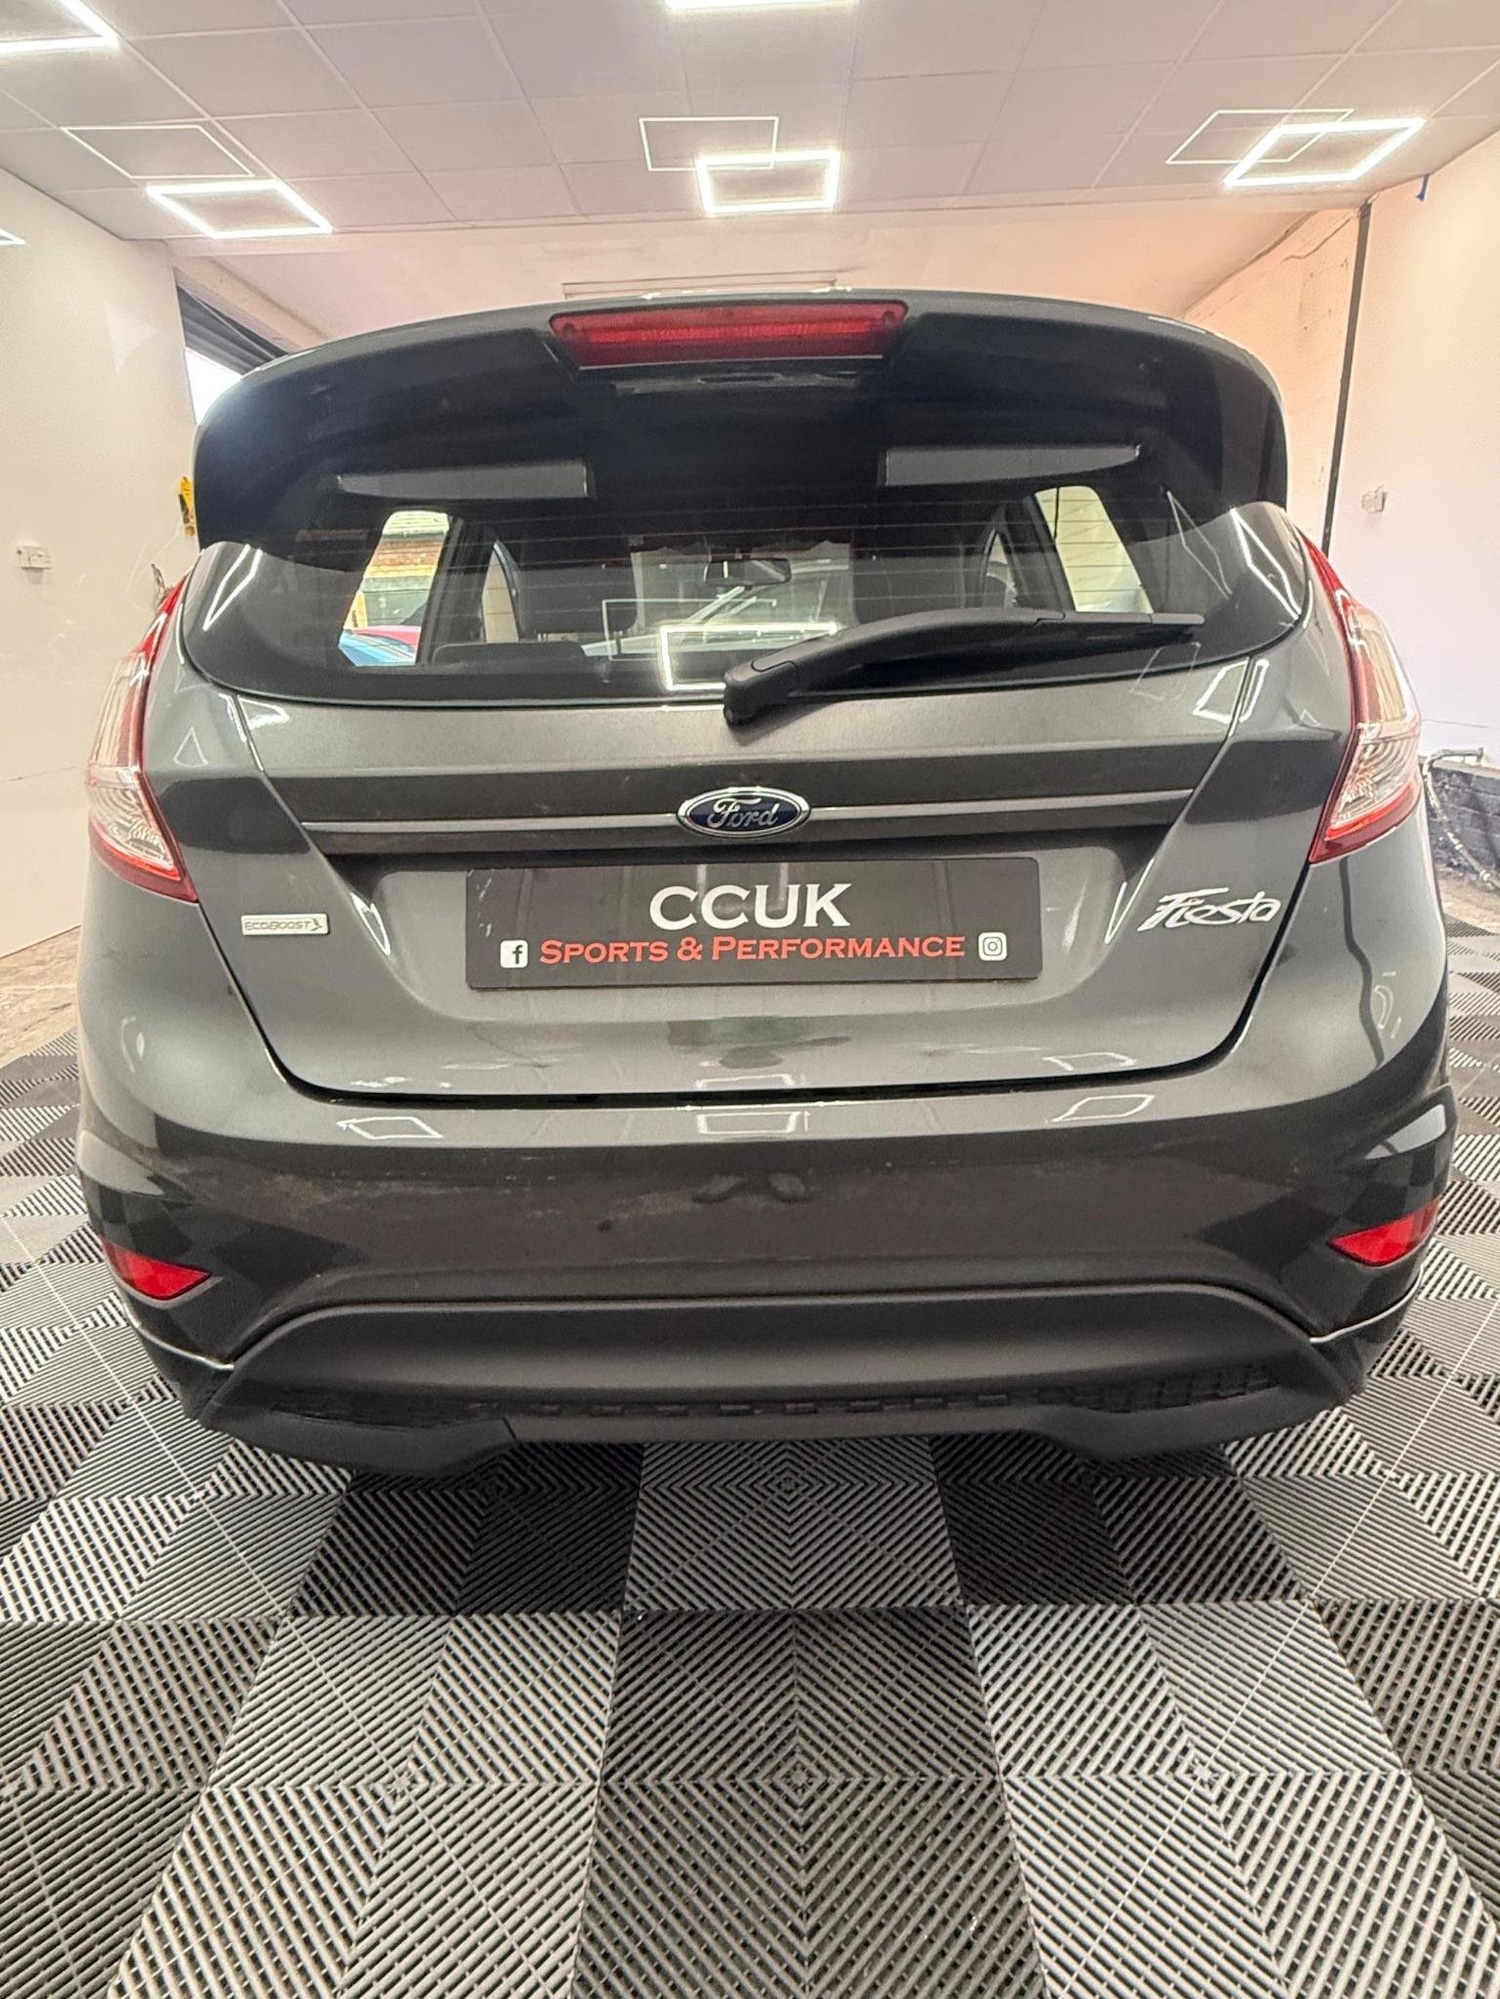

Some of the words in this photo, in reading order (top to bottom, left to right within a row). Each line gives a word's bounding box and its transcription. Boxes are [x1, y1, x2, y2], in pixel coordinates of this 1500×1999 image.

[706, 798, 780, 828] Ford
[649, 883, 852, 931] CCUK
[1136, 887, 1281, 931] Fiesta
[244, 921, 312, 931] ECOBOOST
[539, 938, 668, 965] SPORTS
[677, 938, 702, 961] &
[710, 934, 966, 961] PERFORMANCE
